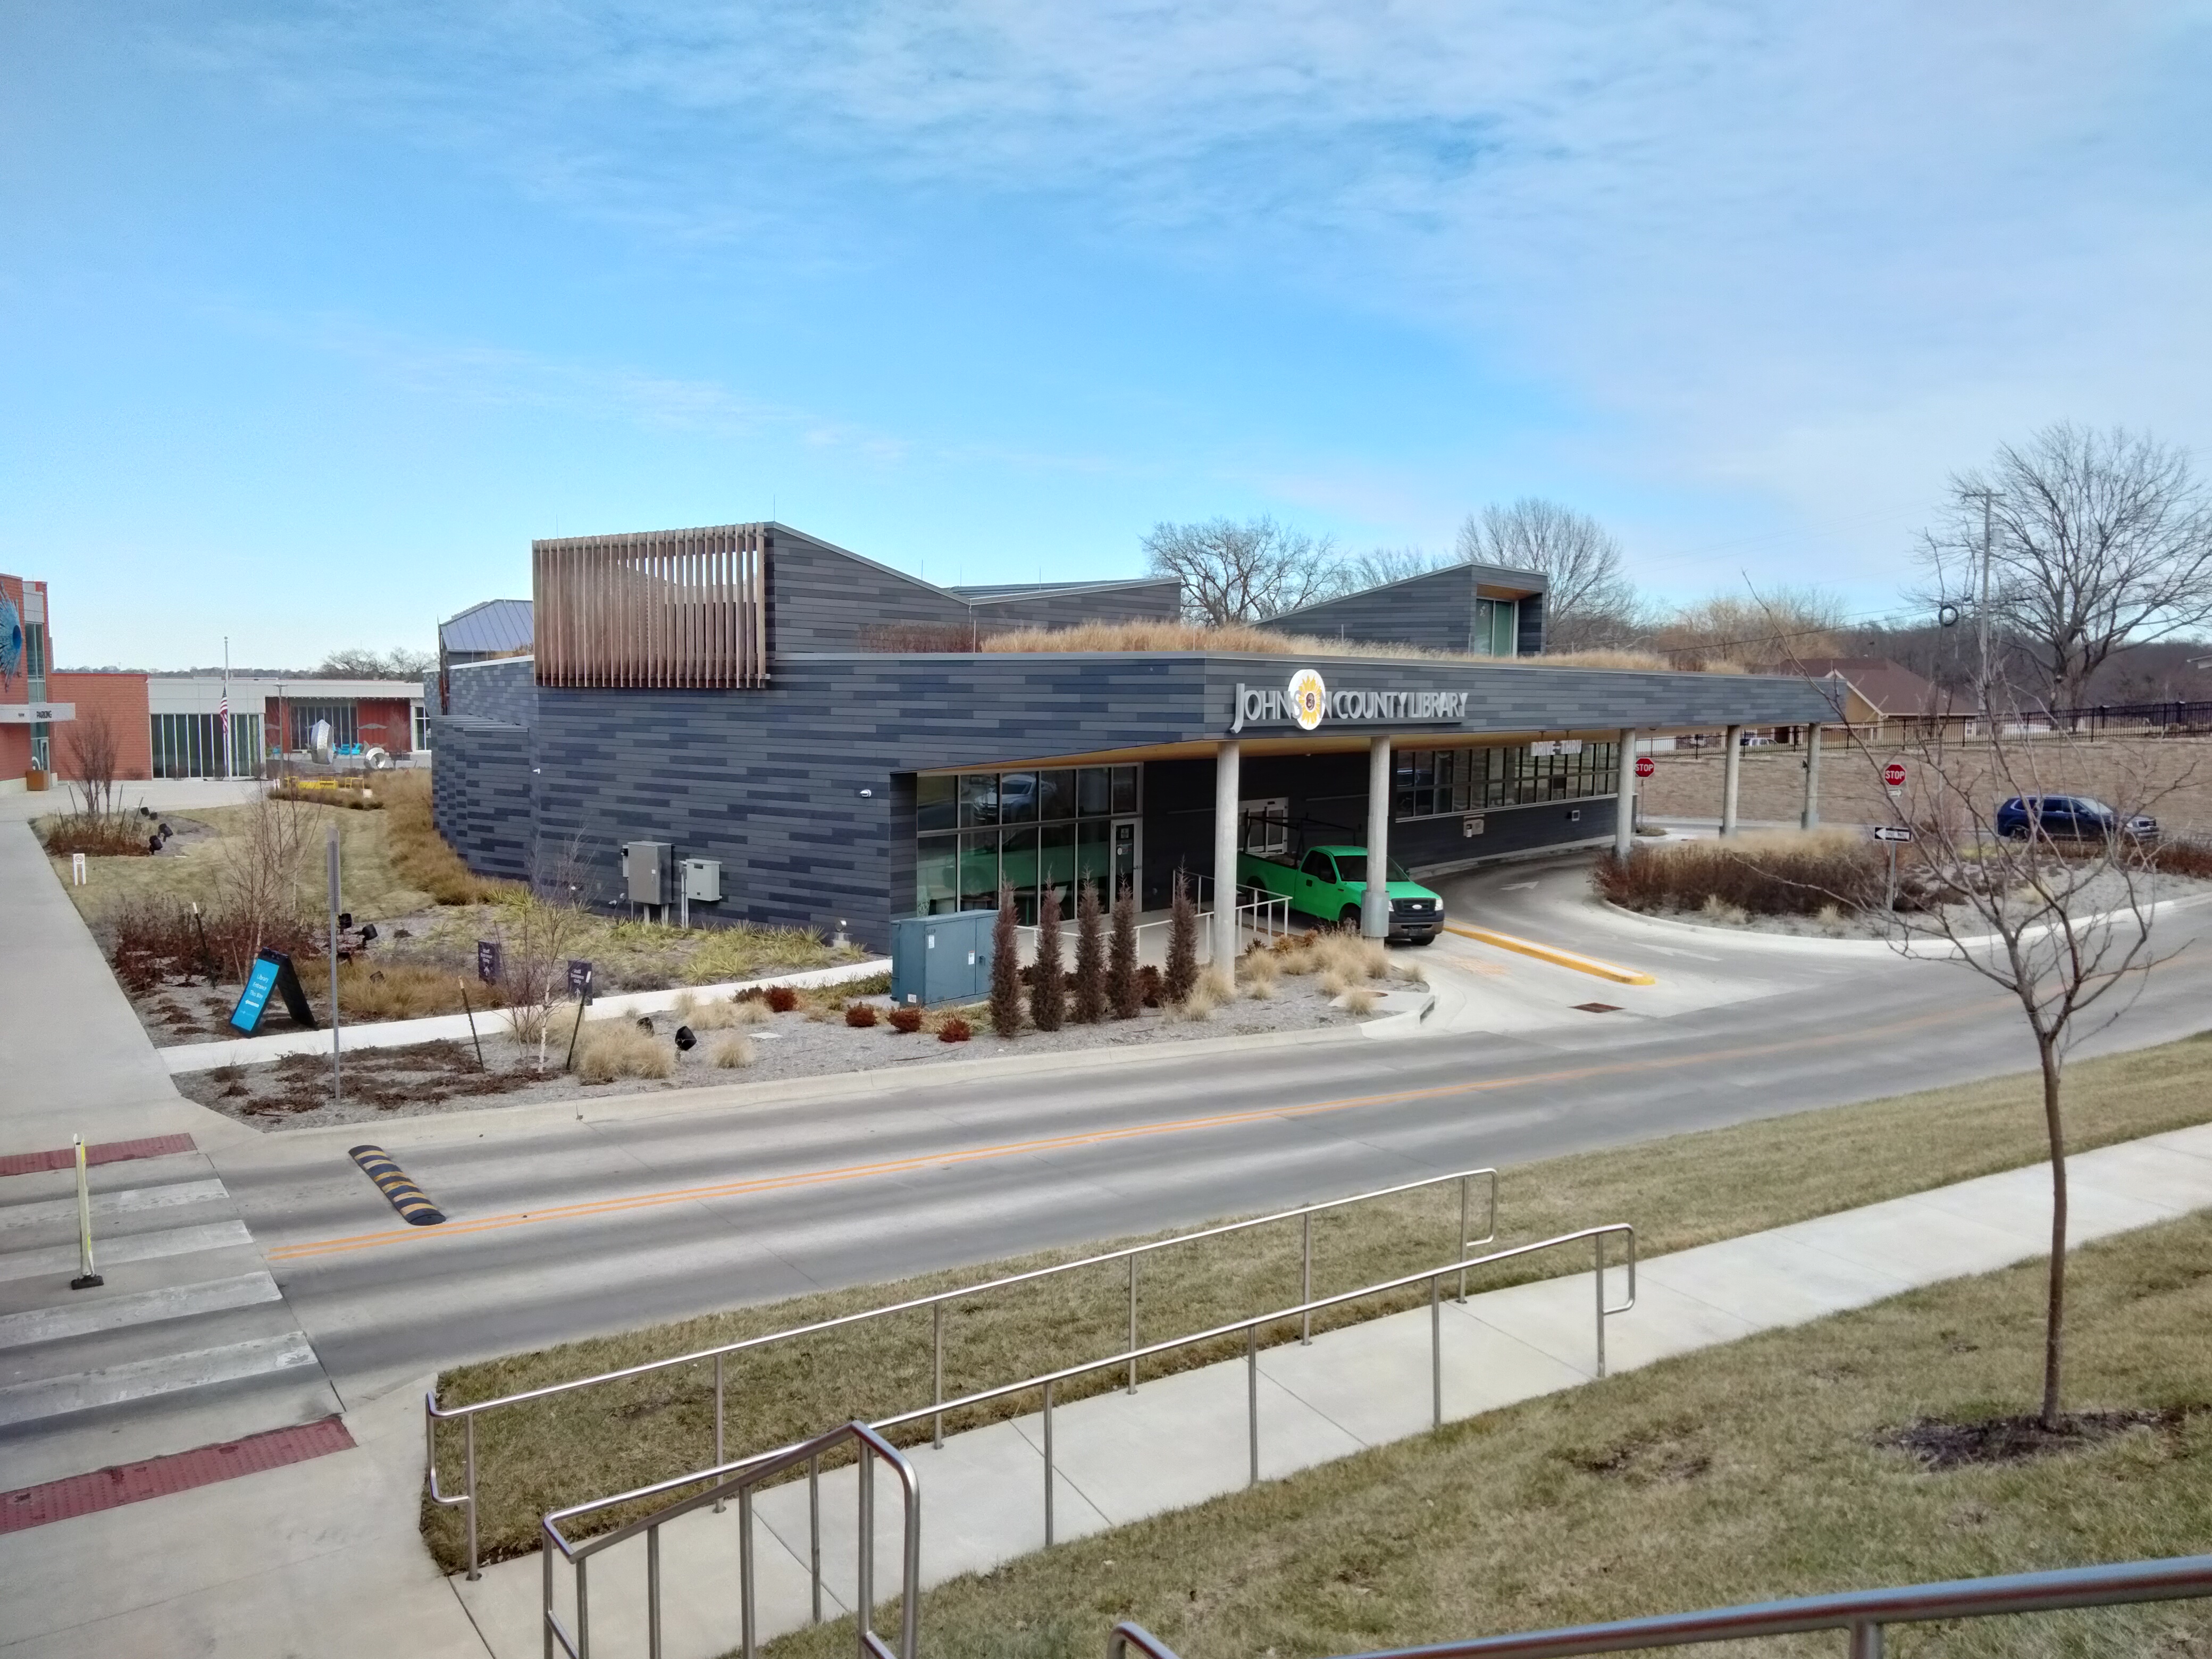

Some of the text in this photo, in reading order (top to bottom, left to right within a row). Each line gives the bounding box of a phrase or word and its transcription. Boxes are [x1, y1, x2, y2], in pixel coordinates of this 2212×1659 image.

[1333, 691, 1408, 719] COUNTY
[1409, 692, 1469, 718] LIBRARY
[1531, 739, 1582, 756] DRIVE-THRU
[1885, 770, 1905, 780] STOP
[257, 974, 269, 983] Library
[253, 982, 267, 991] Entrance
